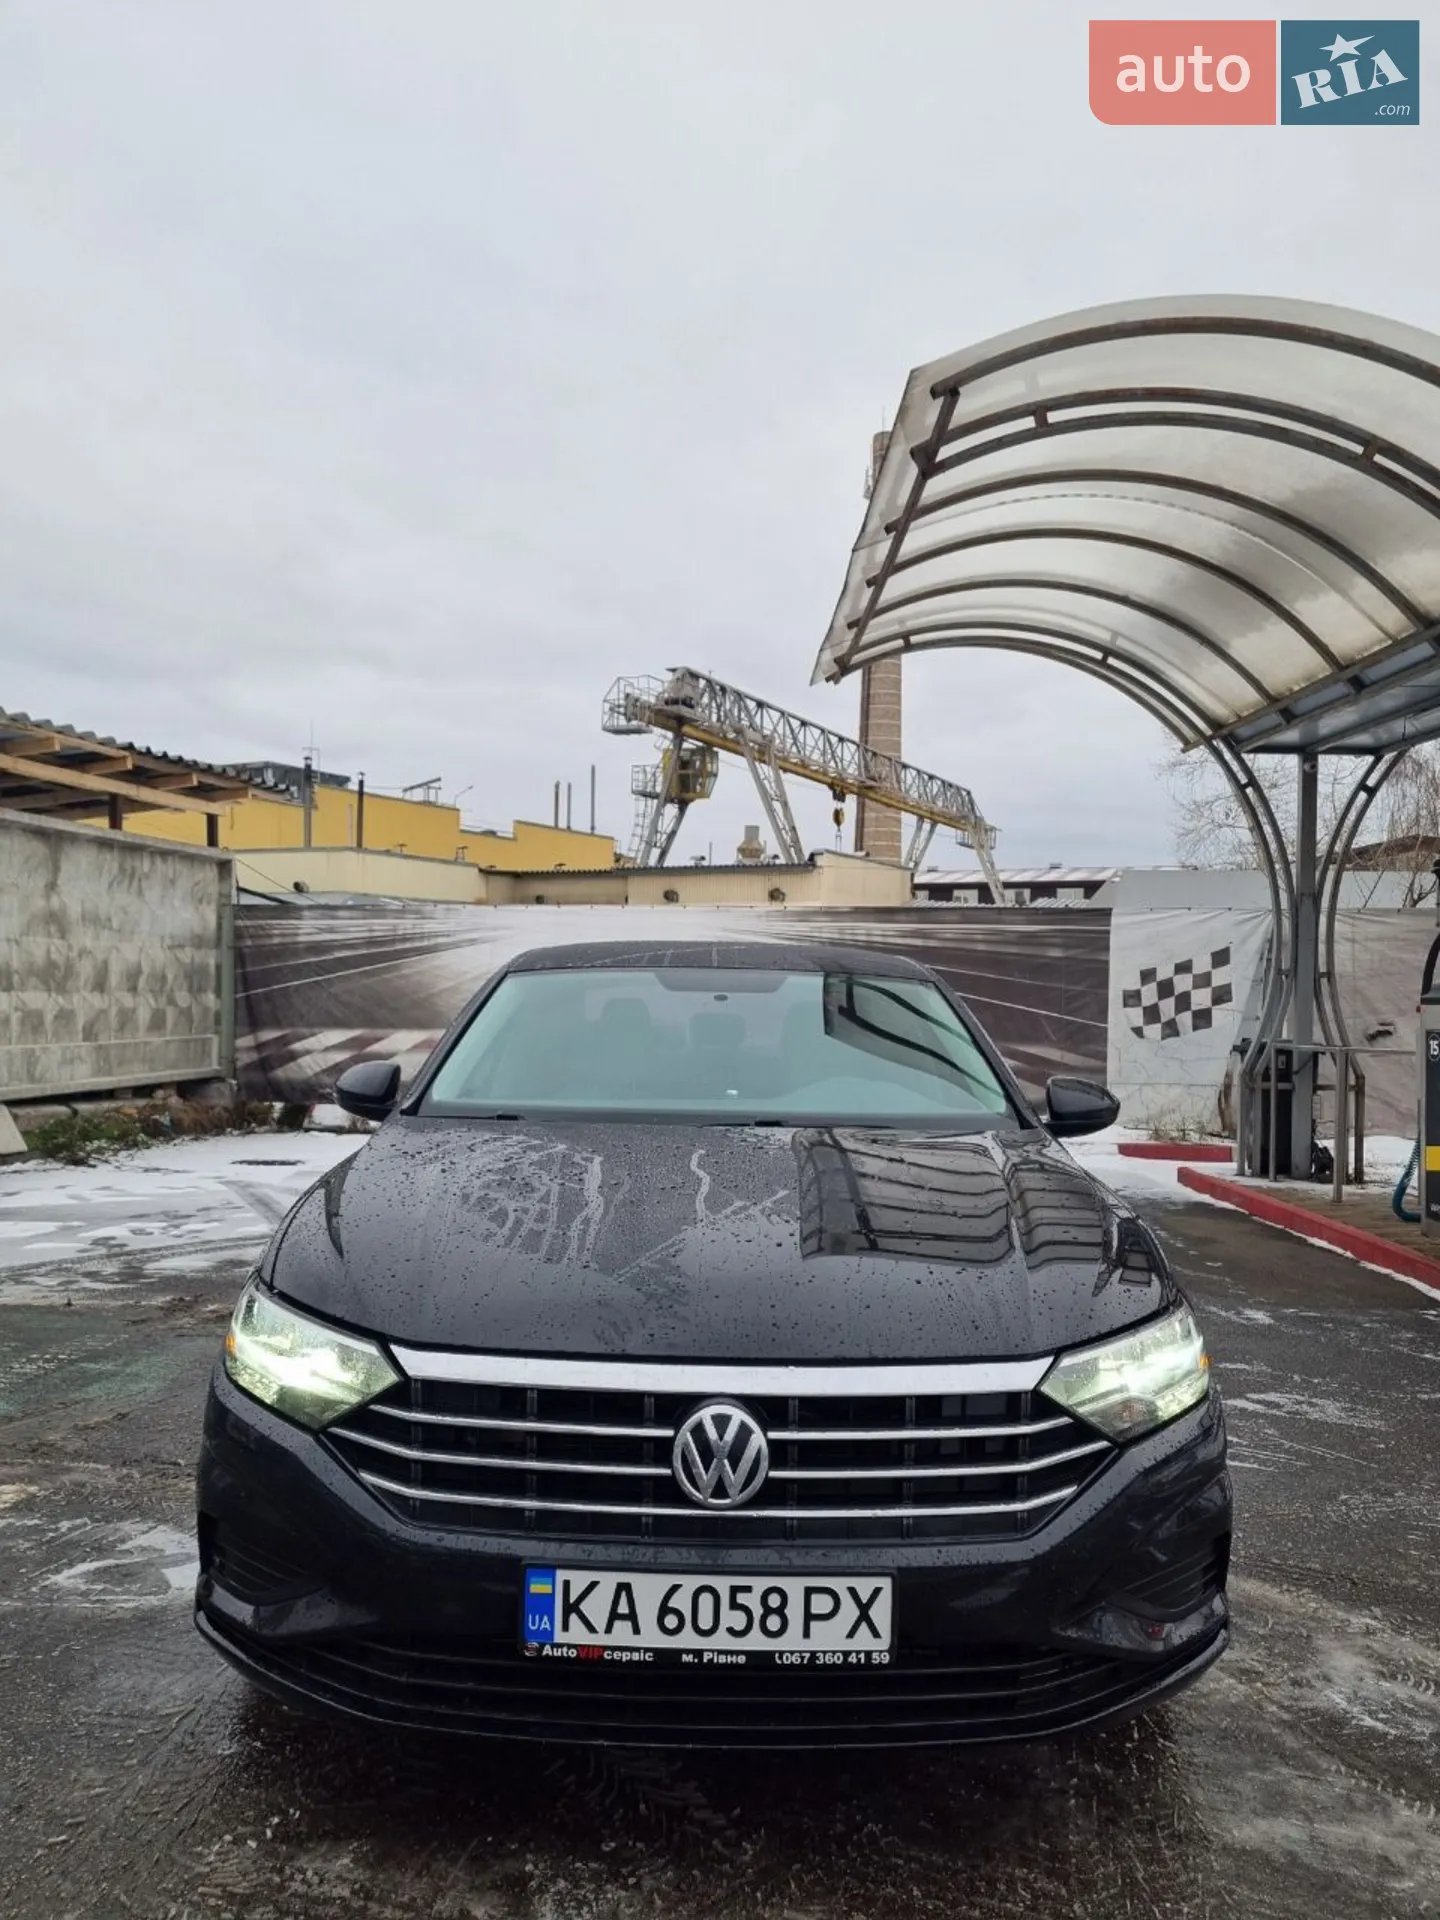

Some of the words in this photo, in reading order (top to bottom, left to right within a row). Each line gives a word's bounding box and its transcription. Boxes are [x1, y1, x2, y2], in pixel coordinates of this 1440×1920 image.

[561, 1579, 641, 1636] KA
[656, 1583, 790, 1639] 6058
[802, 1586, 884, 1640] PX
[528, 1613, 551, 1631] UA
[703, 1651, 746, 1664] Рівне
[782, 1652, 810, 1664] 067
[815, 1652, 843, 1664] 360
[848, 1652, 865, 1664] 41
[871, 1651, 890, 1664] 59
